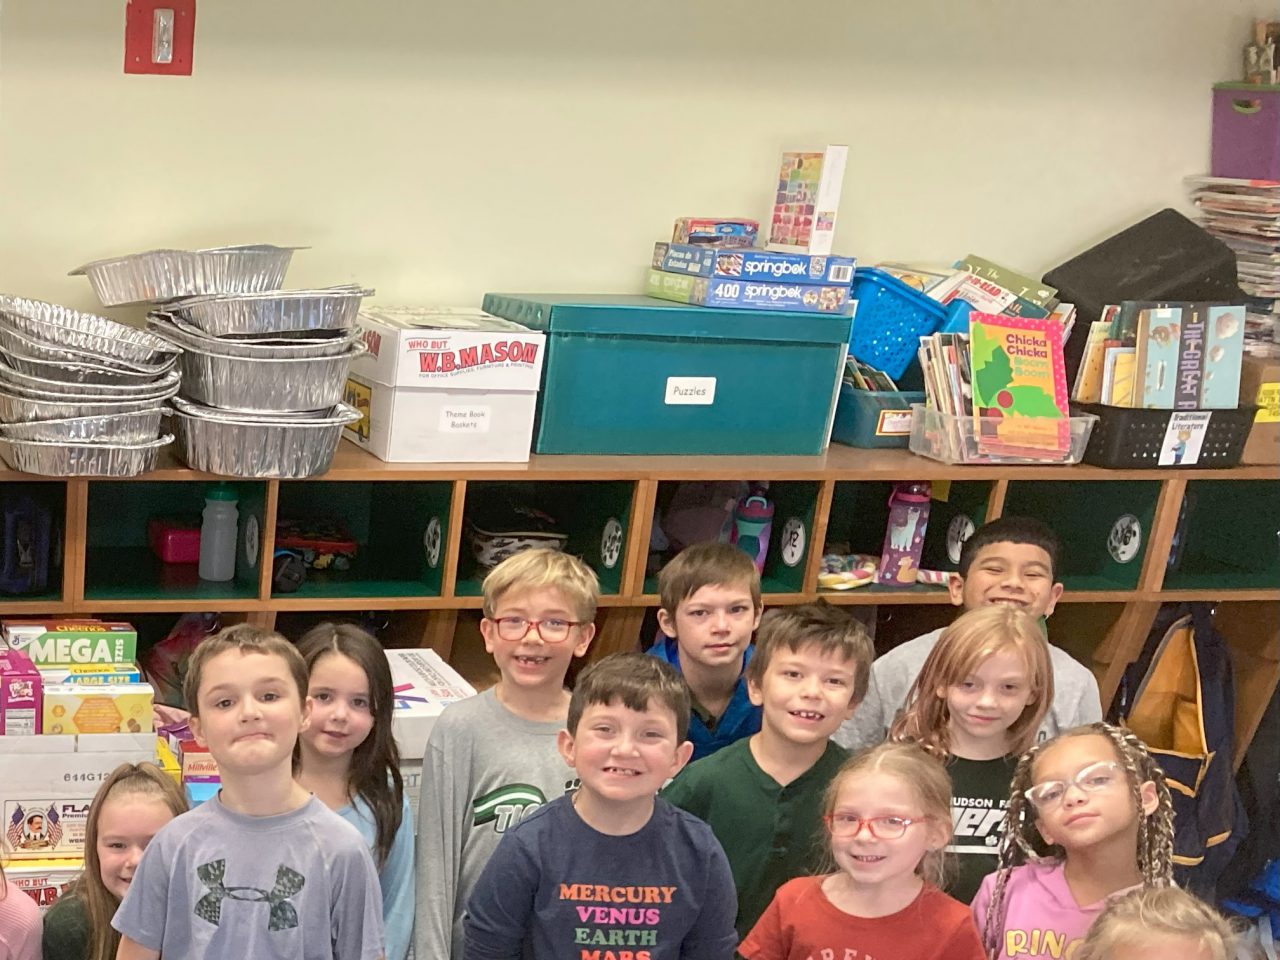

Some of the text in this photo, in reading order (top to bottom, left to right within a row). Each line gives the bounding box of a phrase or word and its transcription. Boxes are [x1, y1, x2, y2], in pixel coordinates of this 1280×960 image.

[744, 258, 808, 277] springbok
[715, 283, 802, 300] 400 springbok
[408, 340, 448, 349] WHO BUT
[1006, 333, 1047, 348] Chicka
[419, 341, 539, 373] W.B.MASON
[1006, 345, 1048, 359] Chicka
[1014, 357, 1048, 368] Boom
[1014, 368, 1049, 379] Boom
[673, 386, 706, 396] Puzzles
[1173, 412, 1209, 422] Traditional
[1171, 422, 1205, 431] Literature
[28, 638, 113, 664] MEGA
[115, 639, 124, 663] SIZE
[70, 675, 131, 684] LARGE SIZE
[950, 797, 993, 808] UDSON
[32, 878, 49, 886] BUT
[560, 883, 677, 904] MERCURY
[576, 906, 661, 925] VENUS
[574, 928, 658, 946] EARTH
